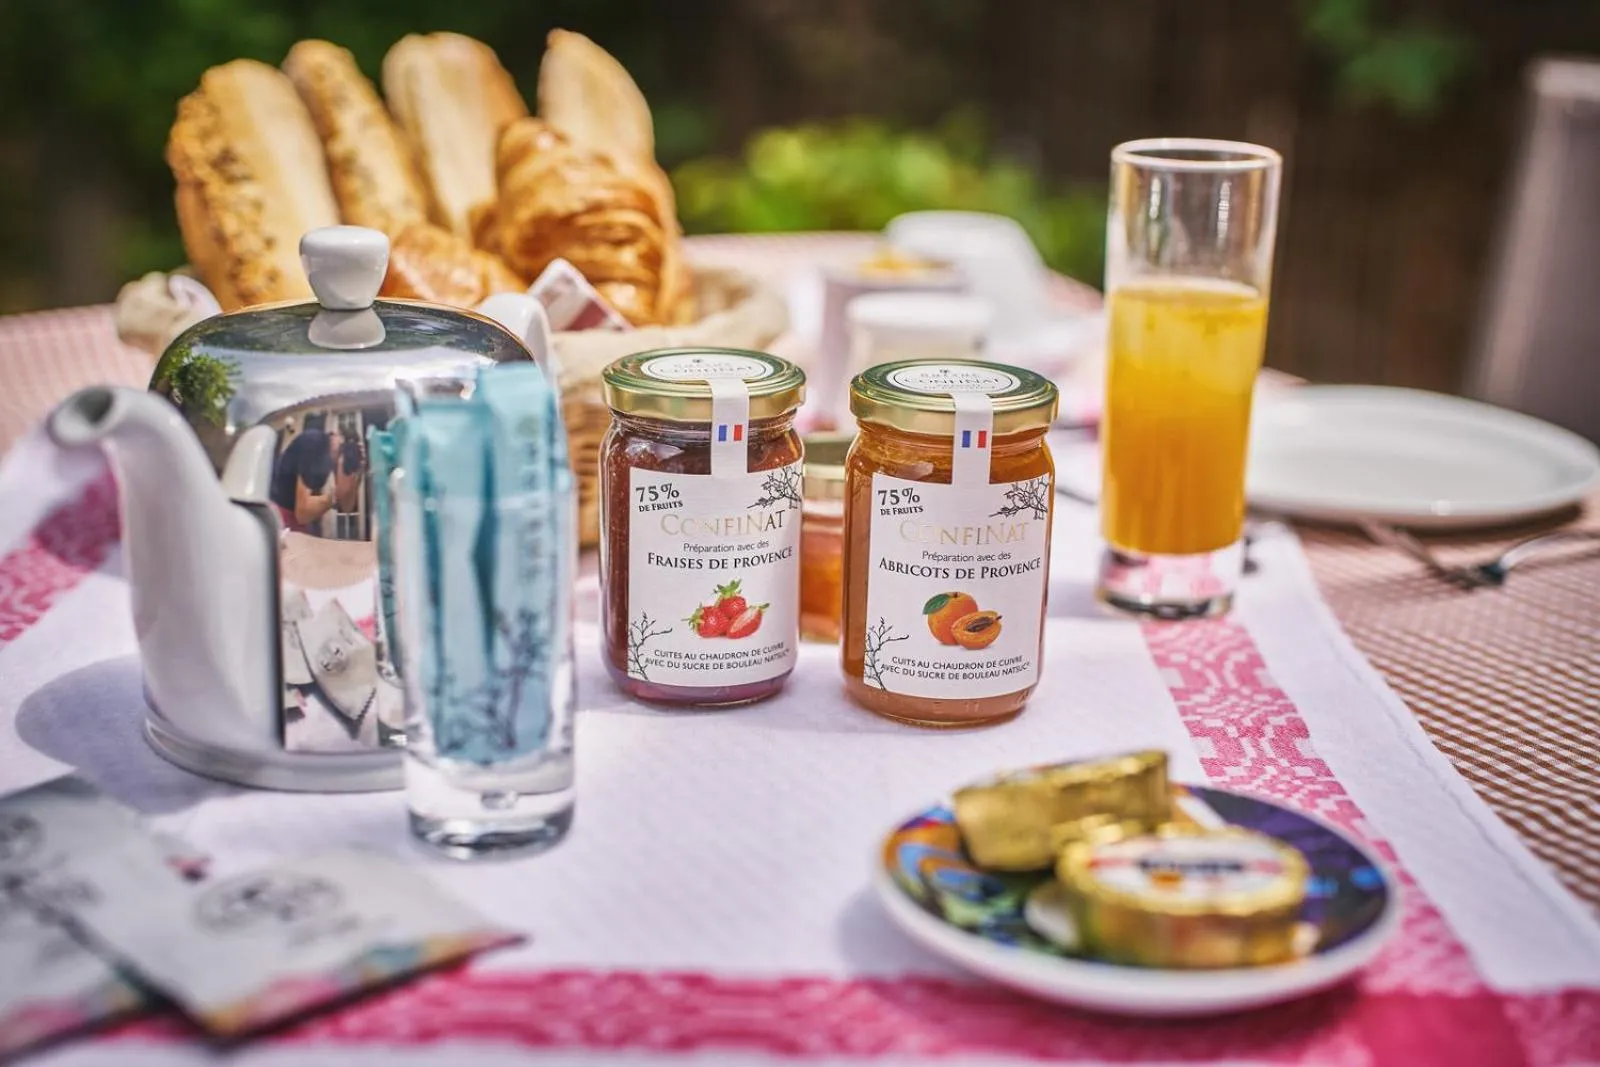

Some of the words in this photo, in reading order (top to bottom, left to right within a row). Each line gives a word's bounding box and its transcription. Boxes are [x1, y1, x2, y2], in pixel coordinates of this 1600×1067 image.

[636, 483, 680, 502] 75%
[877, 487, 920, 506] 75%
[652, 500, 683, 512] FRUITS
[880, 508, 891, 516] DE
[892, 505, 924, 516] FRUITS
[683, 542, 735, 554] Préparation
[737, 544, 755, 552] avec
[758, 540, 769, 550] des
[648, 552, 703, 570] FRAISES
[708, 558, 728, 570] DE
[734, 546, 792, 569] PROVENCE
[922, 551, 974, 562] Préparation
[977, 554, 995, 562] avec
[998, 552, 1011, 560] des
[879, 557, 950, 579] ABRICOTS
[955, 568, 975, 579] DE
[981, 557, 1041, 579] PROVENCE
[654, 649, 682, 660] CUITES
[699, 651, 749, 661] CHAUDRON
[751, 649, 761, 657] DE
[645, 658, 664, 668] AVEC
[667, 661, 680, 669] DU
[682, 662, 709, 671] SUCRE
[712, 662, 724, 670] DE
[726, 657, 762, 669] BOULEAU
[891, 656, 916, 667] CUITS
[917, 660, 930, 669] AU
[932, 661, 984, 670] CHAUDRON
[986, 660, 997, 669] DE
[999, 655, 1023, 666] CUIVRE
[881, 664, 900, 673] AVEC
[902, 667, 916, 677] DU
[917, 671, 945, 680] SUCRE
[948, 672, 960, 680] DE
[962, 669, 1000, 680] BOULEAU
